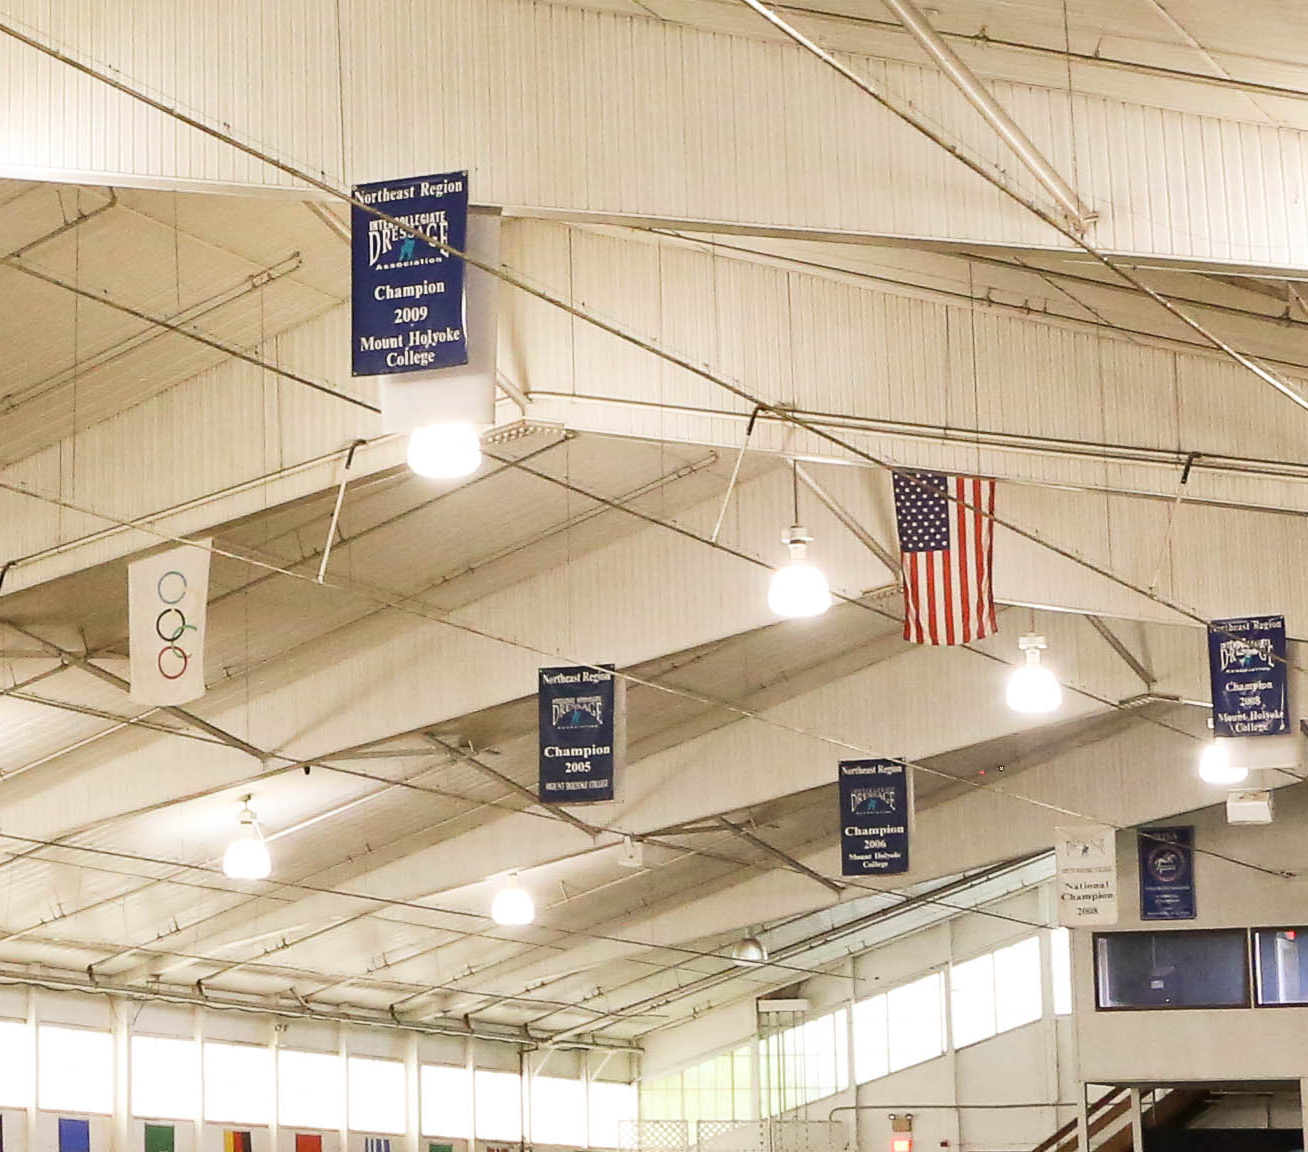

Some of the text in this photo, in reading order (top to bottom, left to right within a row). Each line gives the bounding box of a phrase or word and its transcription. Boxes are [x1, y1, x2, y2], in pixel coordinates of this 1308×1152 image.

[354, 179, 463, 205] Northeast Region
[374, 280, 445, 301] Champion
[394, 306, 428, 324] 2009
[360, 327, 461, 352] Mount Holyoke
[386, 348, 436, 367] College
[1210, 620, 1282, 633] rtheast Region
[543, 672, 611, 684] Northeast Region
[1226, 680, 1273, 692] Champion
[1218, 710, 1284, 722] Mount Holyoke
[1235, 722, 1268, 733] College
[544, 744, 610, 758] Champion
[565, 762, 591, 774] 2005
[841, 766, 876, 775] Northeast
[845, 825, 904, 837] Champion
[862, 860, 889, 868] College
[1065, 881, 1109, 890] National
[1061, 892, 1114, 901] Champion
